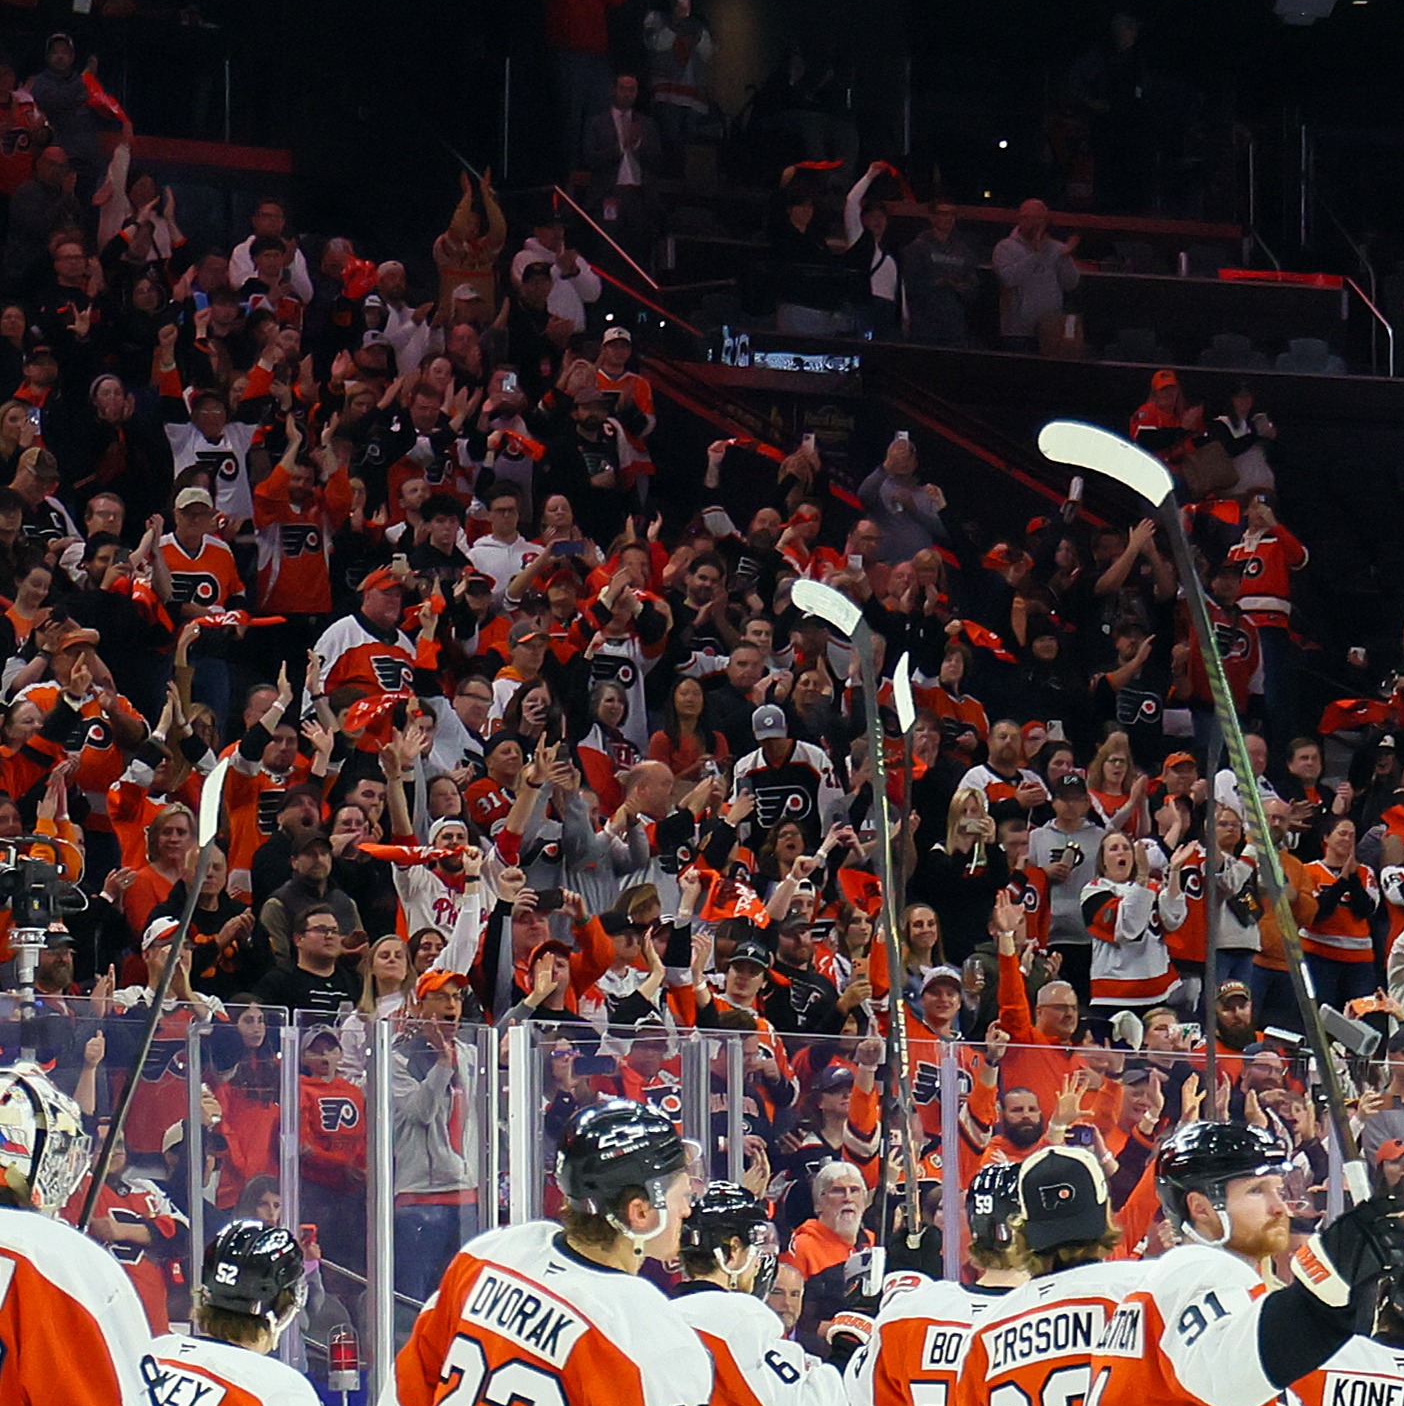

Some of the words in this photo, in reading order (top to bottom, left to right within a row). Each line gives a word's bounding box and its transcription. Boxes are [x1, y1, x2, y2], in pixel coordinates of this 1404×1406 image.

[974, 1191, 994, 1215] 59
[215, 1262, 239, 1286] 52
[471, 1279, 579, 1356] DVORAK
[1176, 1290, 1233, 1348] 91
[930, 1331, 961, 1365] BO
[992, 1311, 1093, 1371] ERSSON
[764, 1350, 801, 1385] 6
